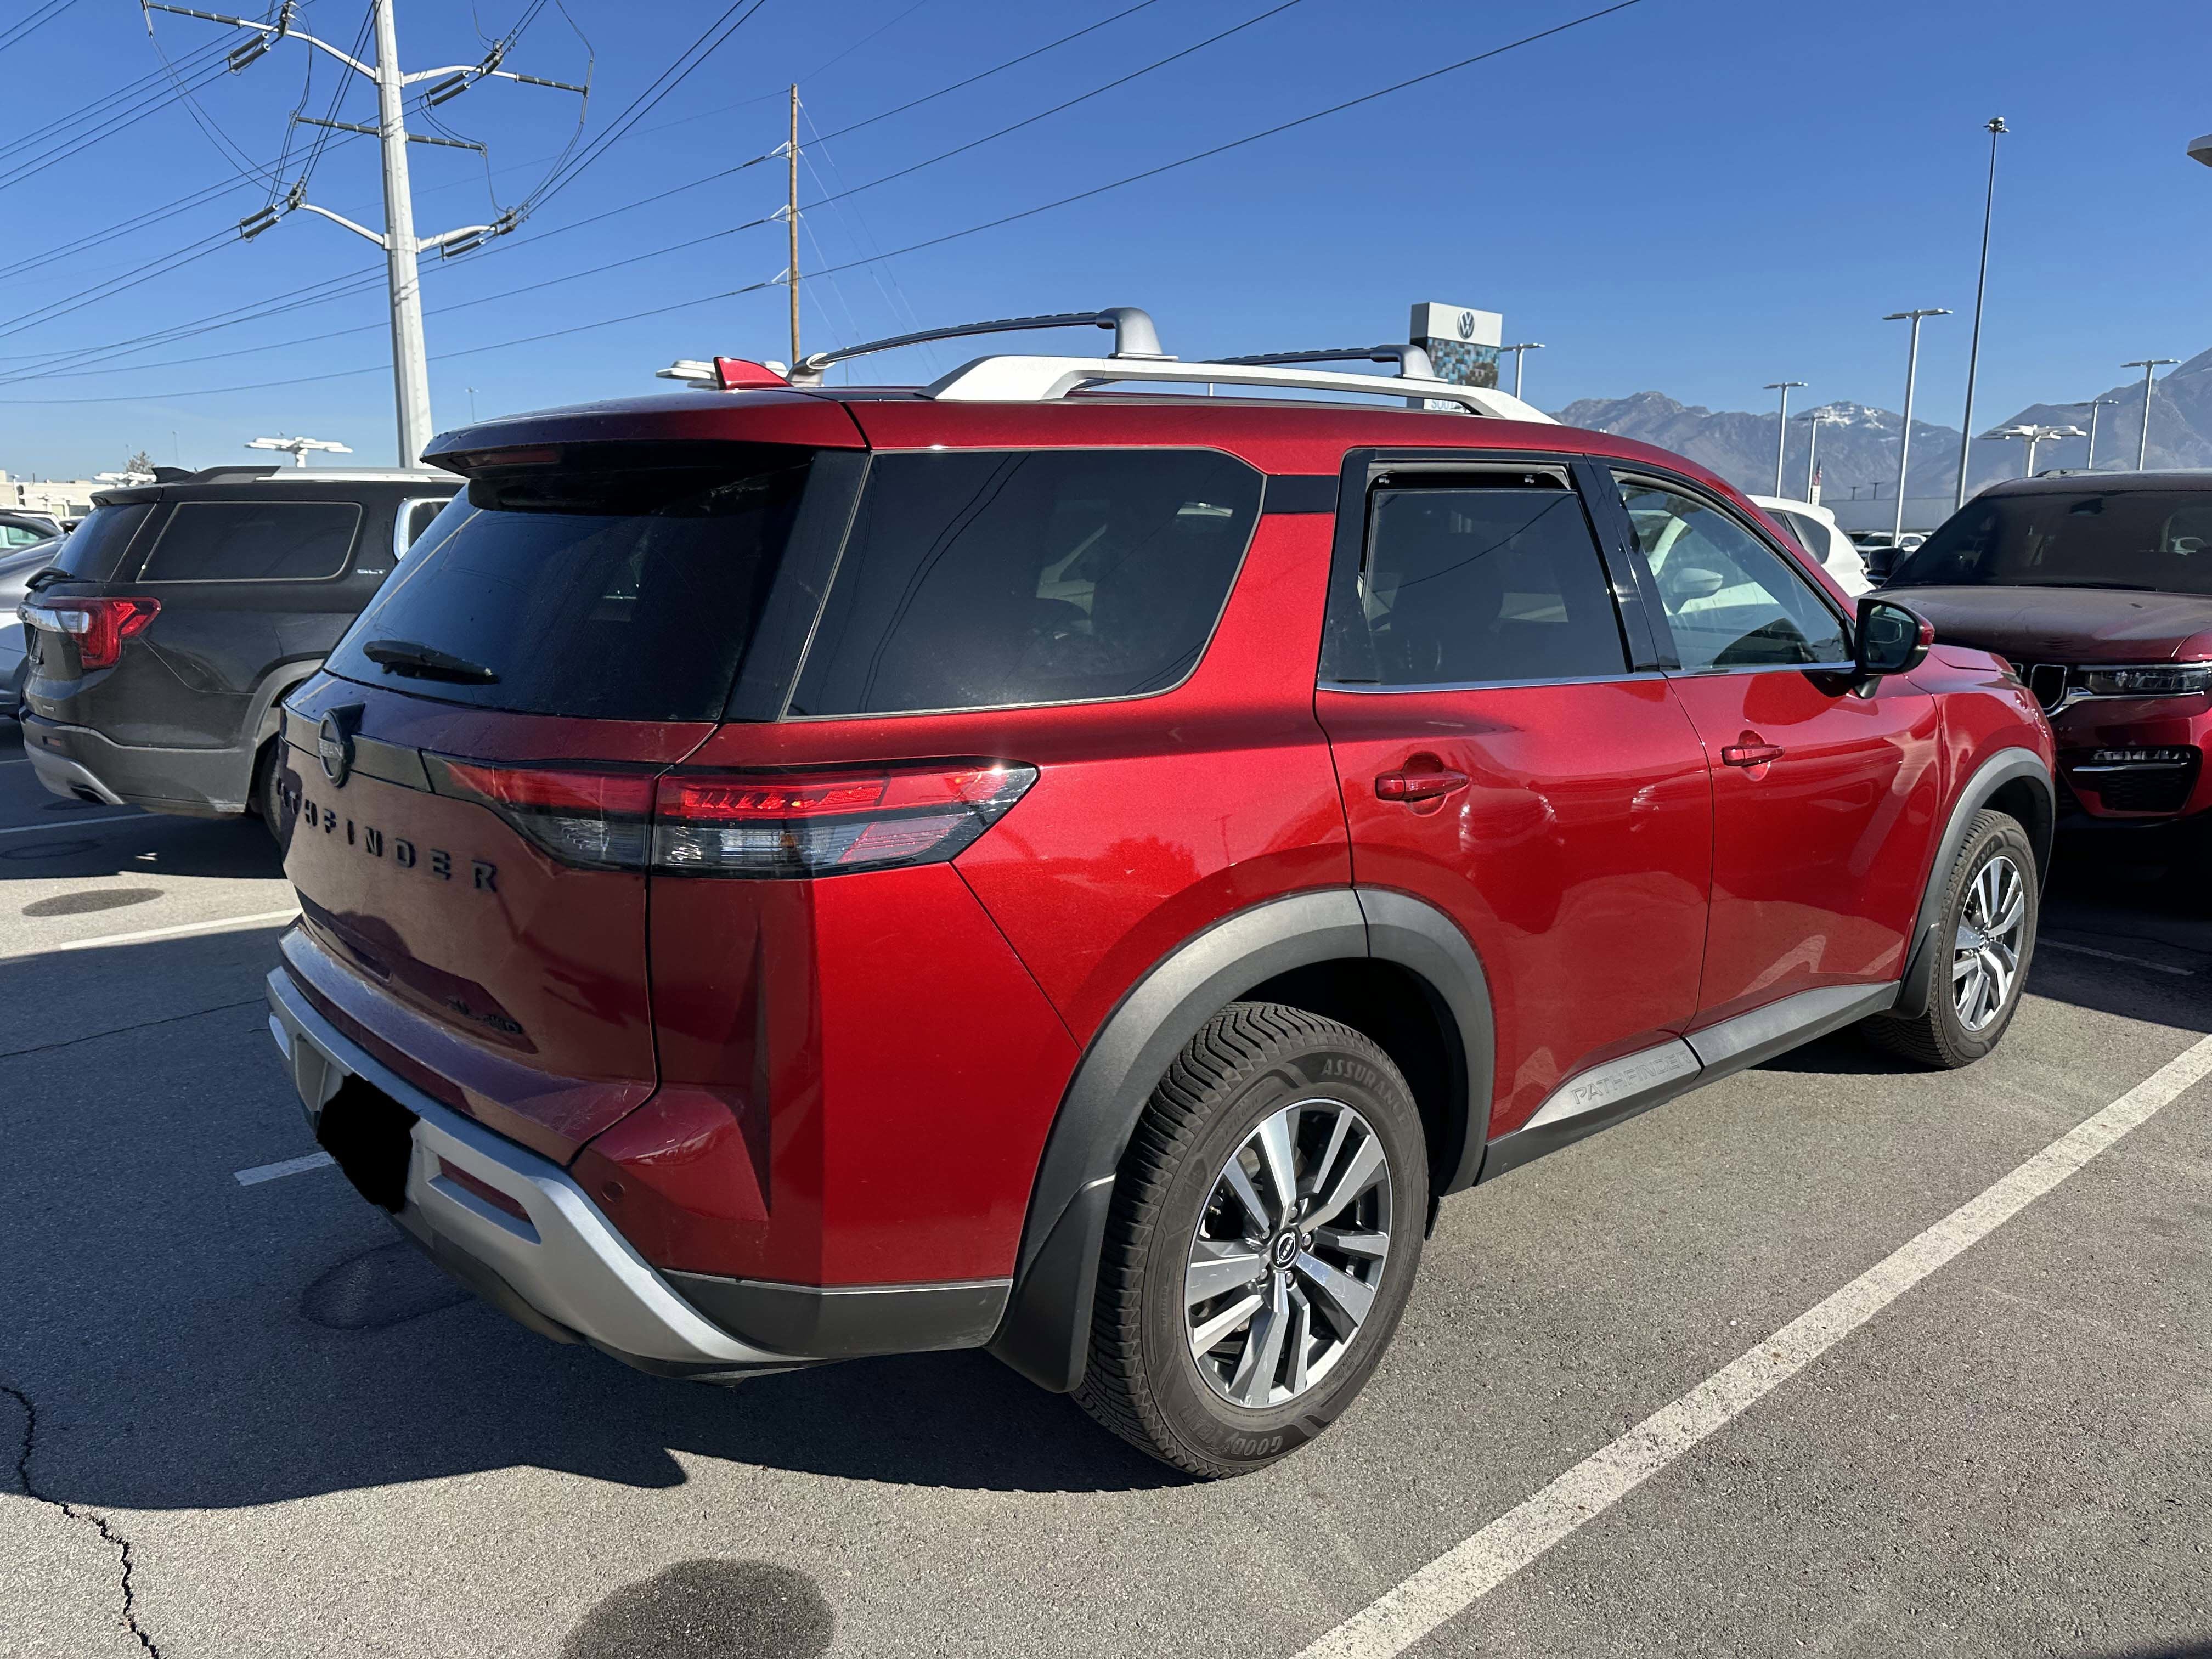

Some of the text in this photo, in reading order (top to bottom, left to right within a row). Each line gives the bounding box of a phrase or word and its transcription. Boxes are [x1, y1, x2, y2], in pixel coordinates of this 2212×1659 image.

[276, 774, 498, 893] THFINDER
[1321, 1058, 1406, 1123] ASSURANCE
[1571, 1049, 1692, 1105] PATHFINDER
